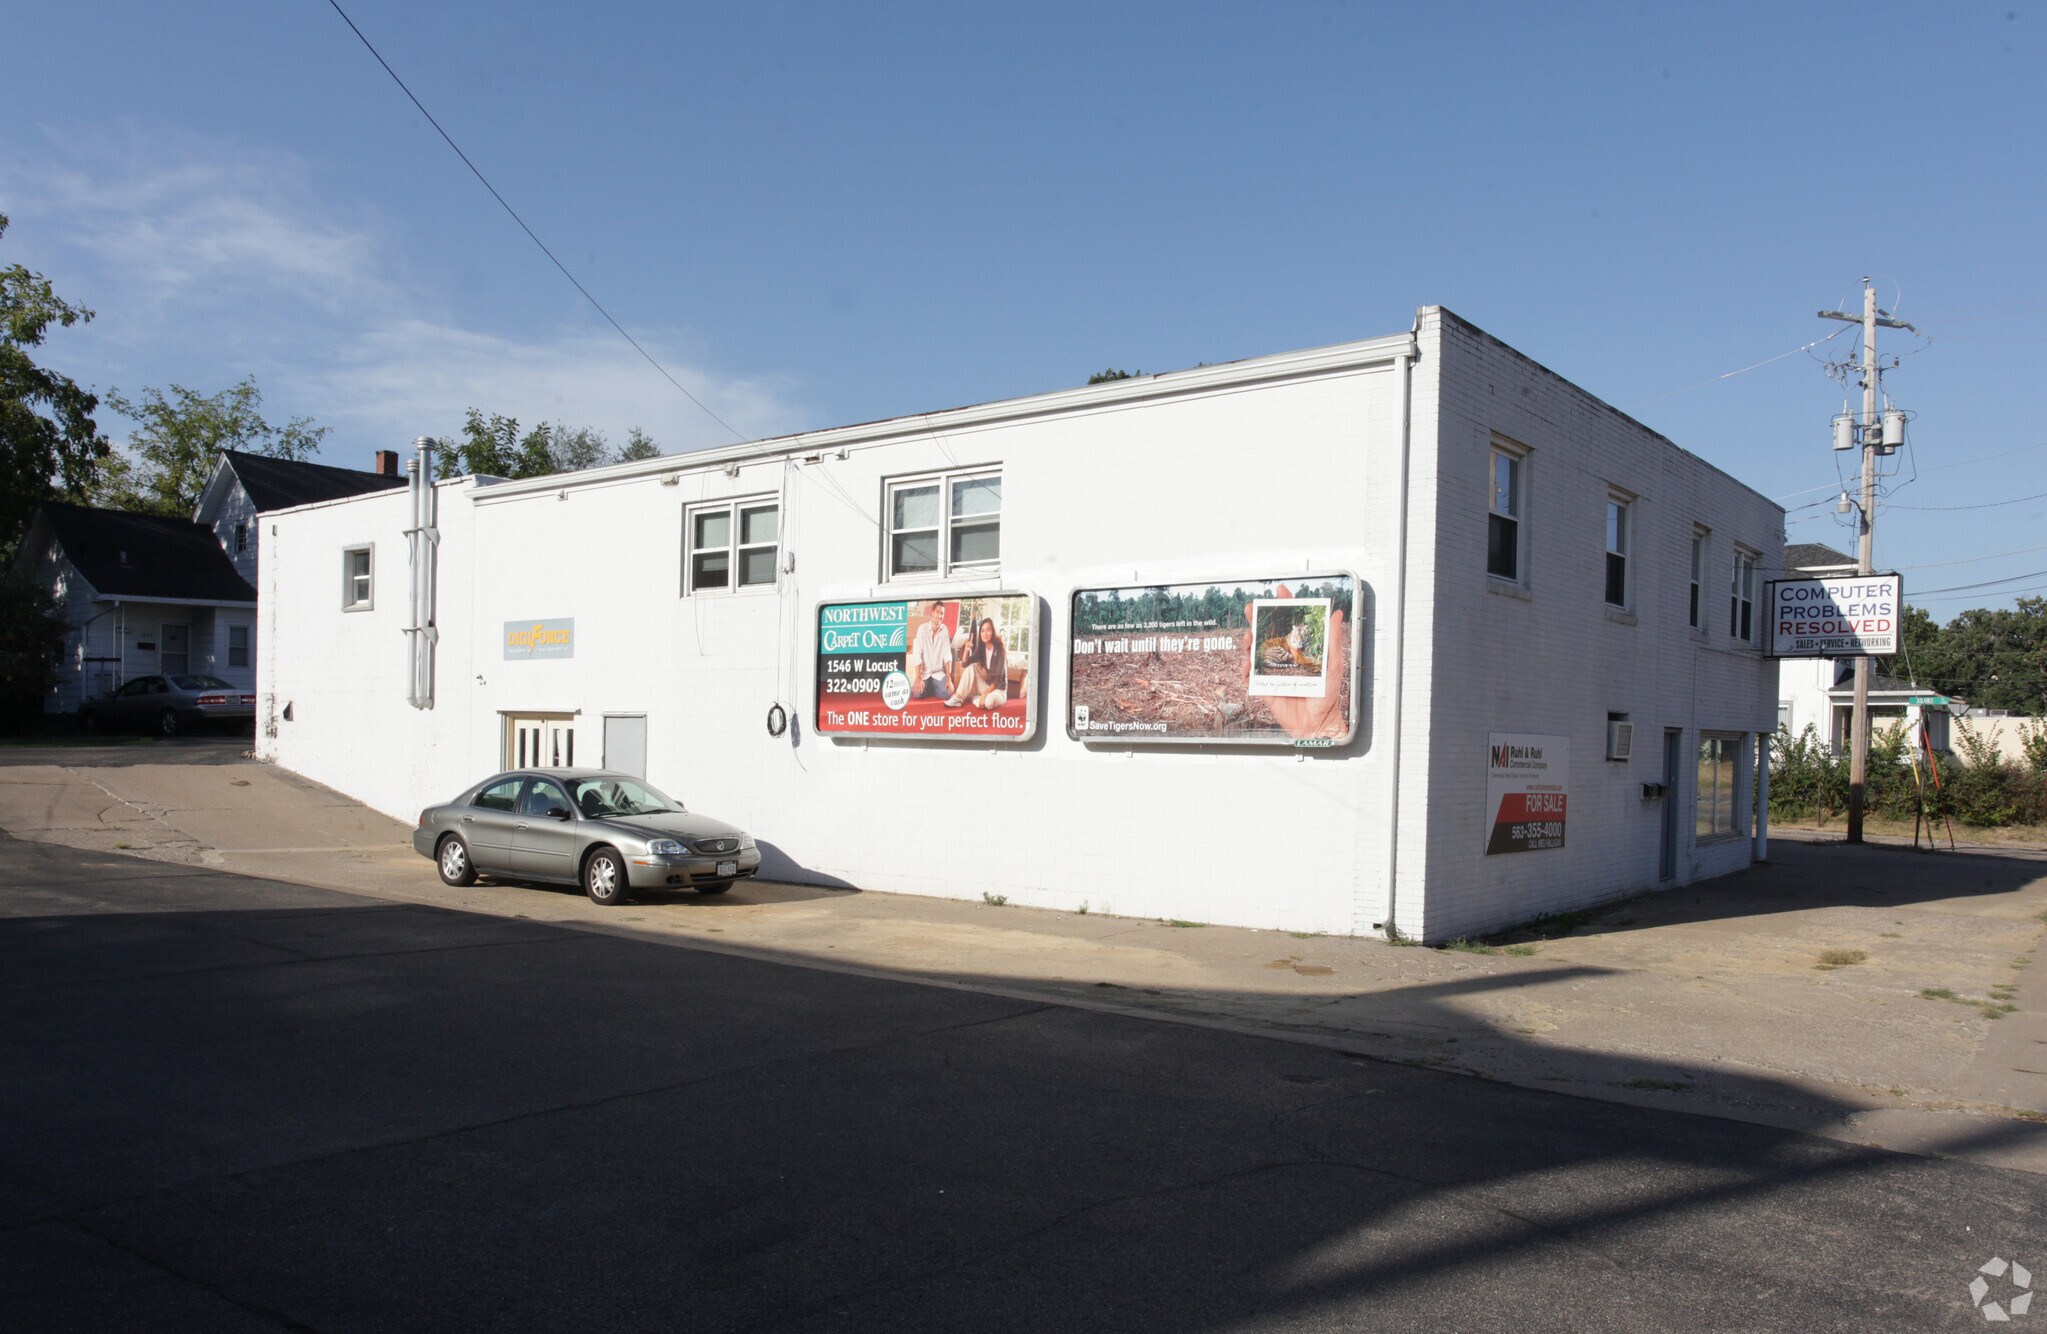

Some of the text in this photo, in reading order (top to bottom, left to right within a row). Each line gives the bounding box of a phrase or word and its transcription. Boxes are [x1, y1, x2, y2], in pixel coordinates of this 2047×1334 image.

[1780, 584, 1892, 601] COMPUTER
[824, 605, 905, 623] NORTHWEST
[1780, 602, 1891, 620] PROBLEMS
[1159, 621, 1175, 629] tigers
[1779, 619, 1891, 635] RESOLVED
[823, 629, 888, 651] CARPET ONE
[1074, 637, 1236, 654] Don't wait until they're gone.
[1795, 637, 1891, 649] SALES SERVICE NETWORKING
[827, 659, 898, 673] 1546 W Locust
[1916, 697, 1933, 705] ADAMS
[827, 711, 1024, 730] The ONE store for your perfect floor.
[1090, 721, 1167, 732] SaveTigersNow.org
[1492, 740, 1509, 768] NAI
[1510, 746, 1542, 759] Ruhl & Ruhl
[1526, 794, 1563, 812] FOR SALE
[1512, 822, 1561, 839] 563-355-4000
